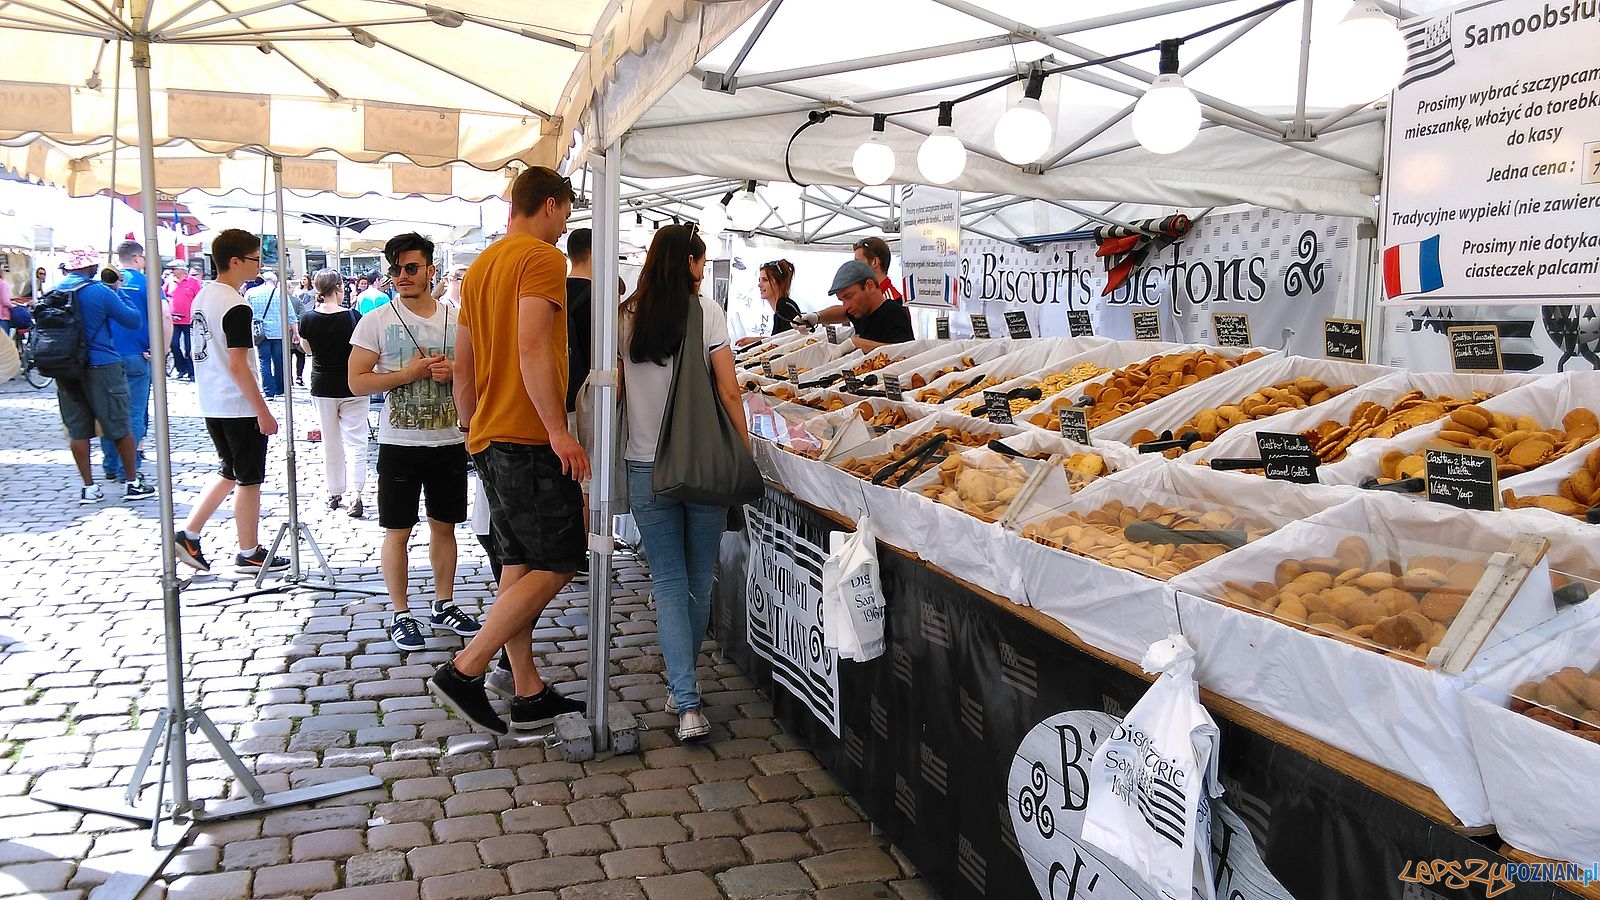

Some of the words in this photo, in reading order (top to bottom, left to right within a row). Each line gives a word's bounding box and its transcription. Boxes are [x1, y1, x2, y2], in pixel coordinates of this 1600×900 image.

[1464, 0, 1600, 48] Samoobsłu
[1417, 94, 1467, 115] Prosimy
[1469, 79, 1520, 106] wybrać
[1405, 116, 1472, 139] mieszankę,
[1475, 103, 1522, 127] włożyć
[1524, 102, 1543, 119] do
[1507, 130, 1525, 146] do
[1528, 126, 1563, 144] kasy
[1487, 165, 1528, 182] Jedna
[1532, 161, 1566, 177] cena
[1392, 207, 1456, 227] Tradycyjne
[1459, 200, 1510, 222] wypieki
[1514, 198, 1540, 218] (nie
[1462, 238, 1517, 257] Prosimy
[1519, 235, 1541, 252] nie
[1544, 232, 1600, 253] dotyka
[979, 250, 1092, 311] Biscuits
[1465, 260, 1534, 279] ciasteczek
[1536, 257, 1600, 279] palcami
